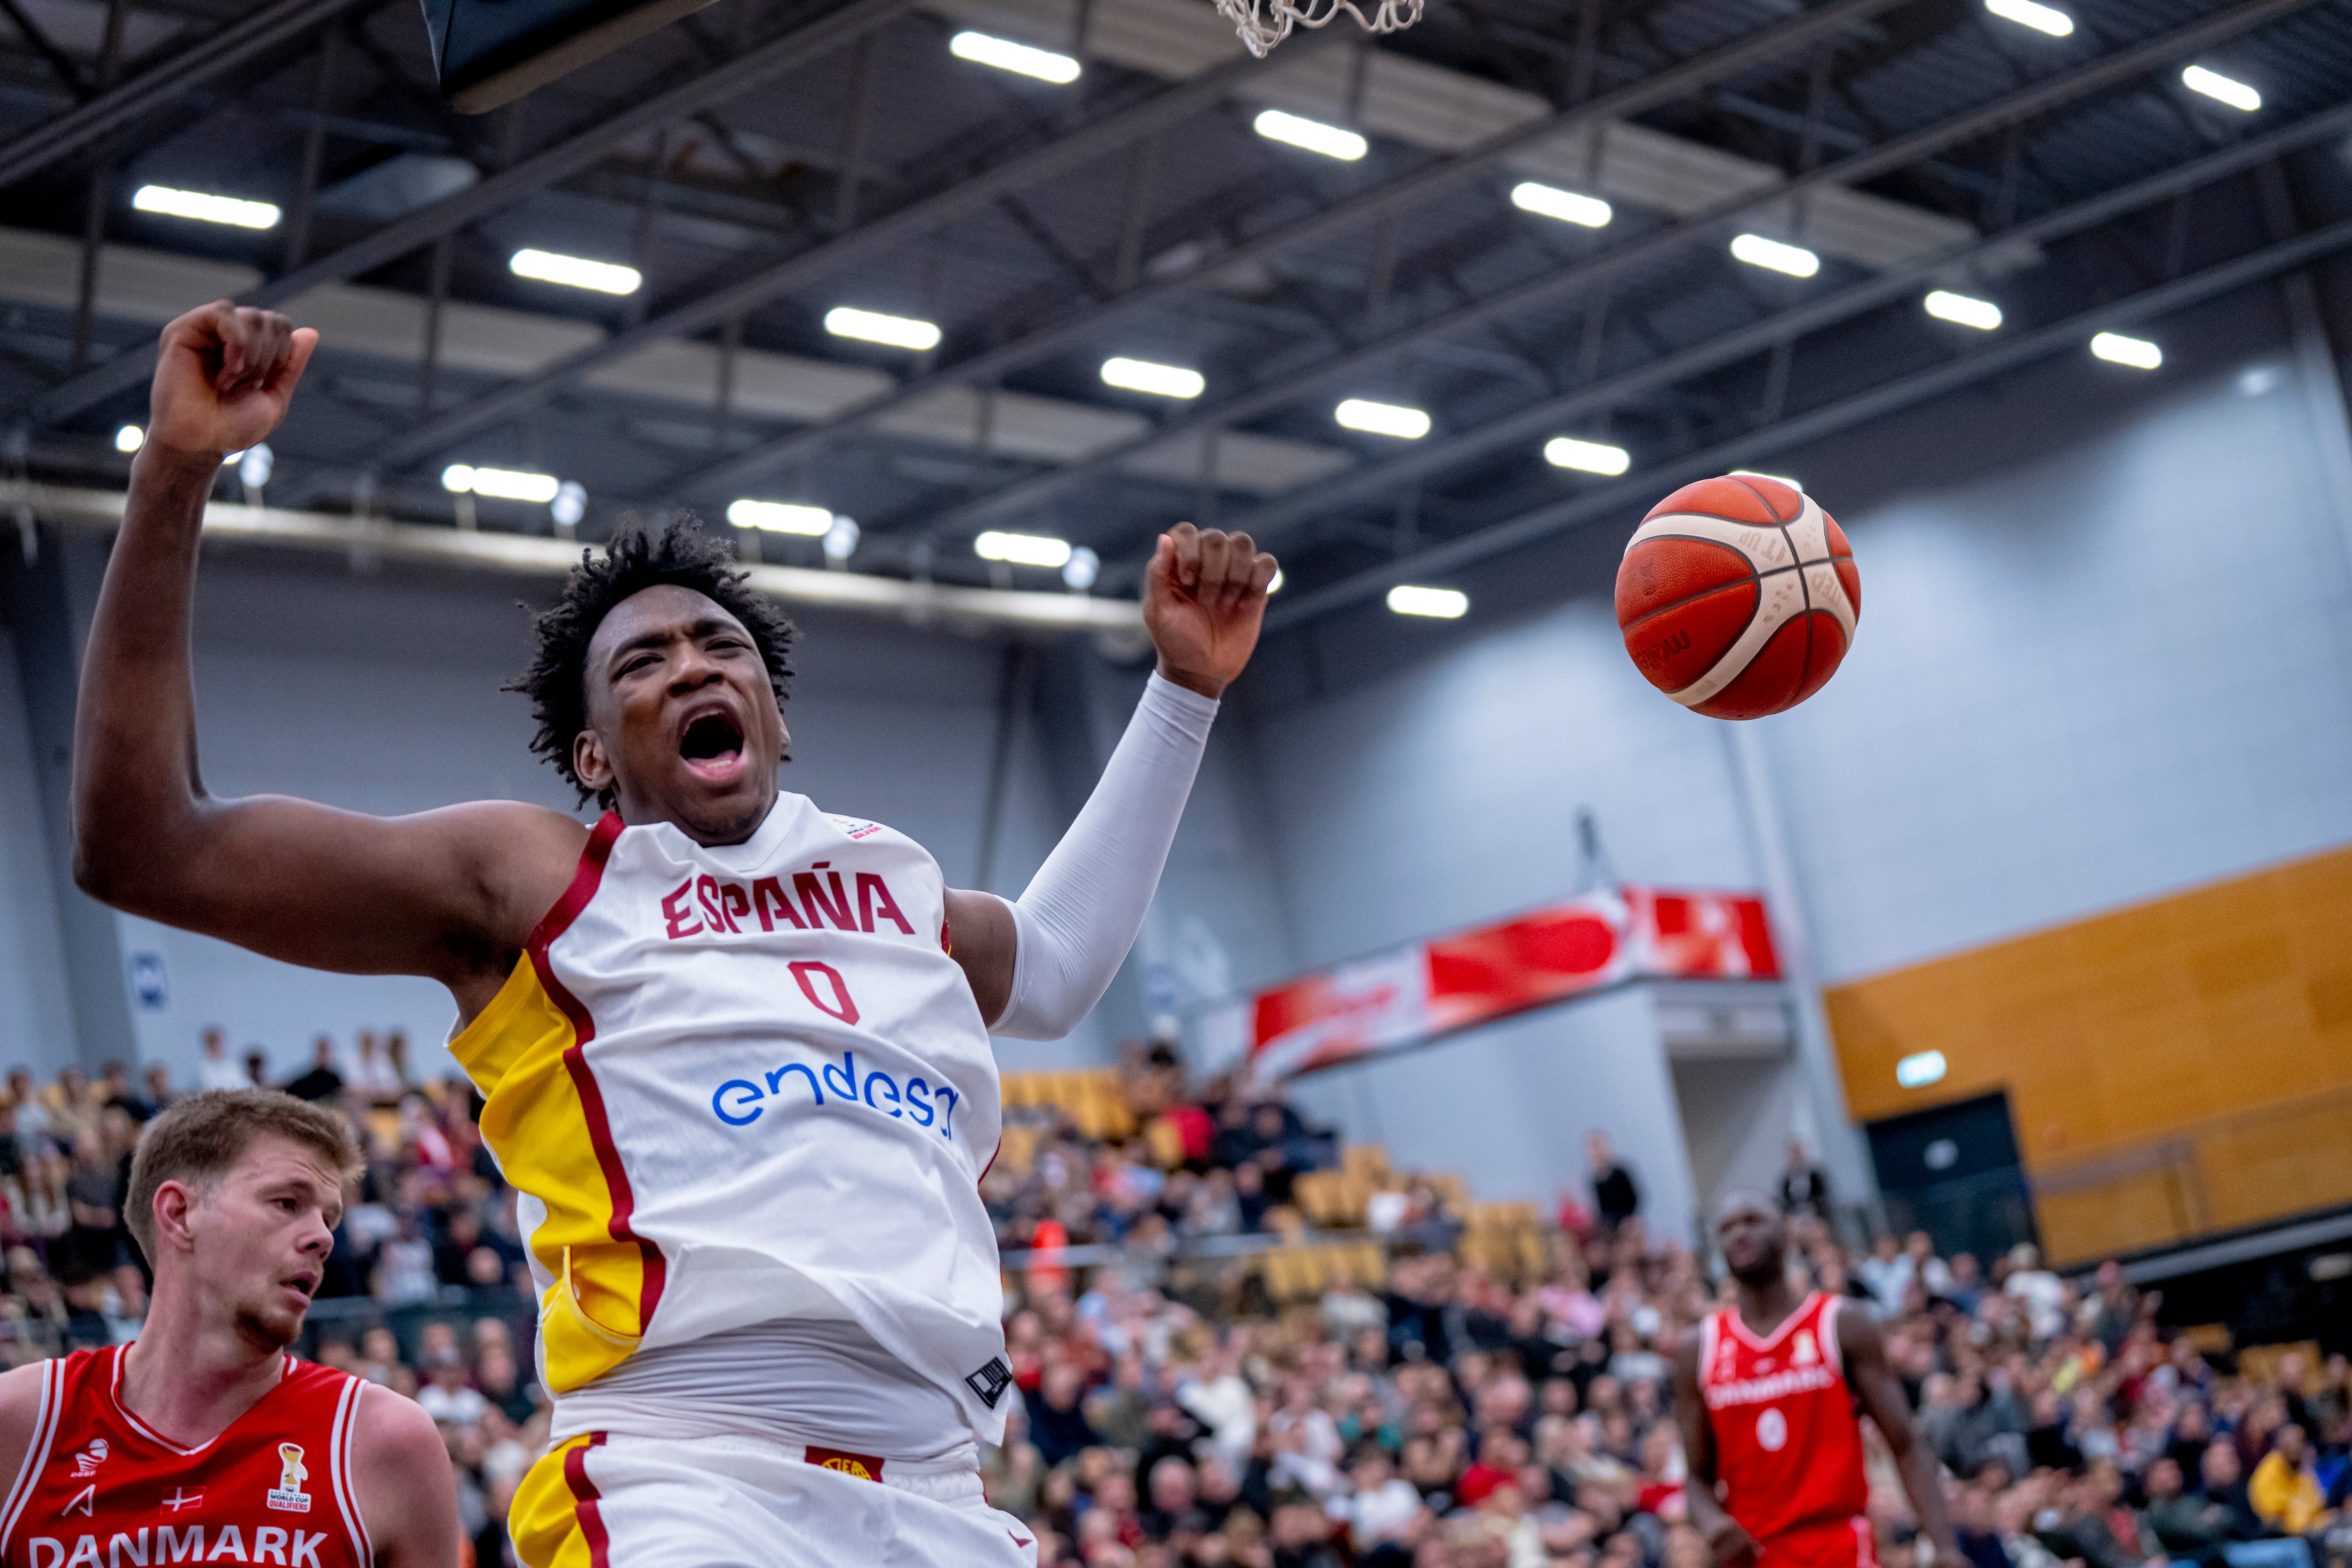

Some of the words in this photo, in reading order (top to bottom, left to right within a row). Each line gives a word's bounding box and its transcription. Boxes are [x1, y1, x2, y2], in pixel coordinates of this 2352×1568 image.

[1739, 530, 1762, 551] UP
[1761, 538, 1787, 563] IT
[661, 861, 915, 939] ESPAÑA
[787, 961, 860, 1026] 0
[269, 1500, 308, 1510] QUALIFIERS
[29, 1525, 328, 1568] DANMARK
